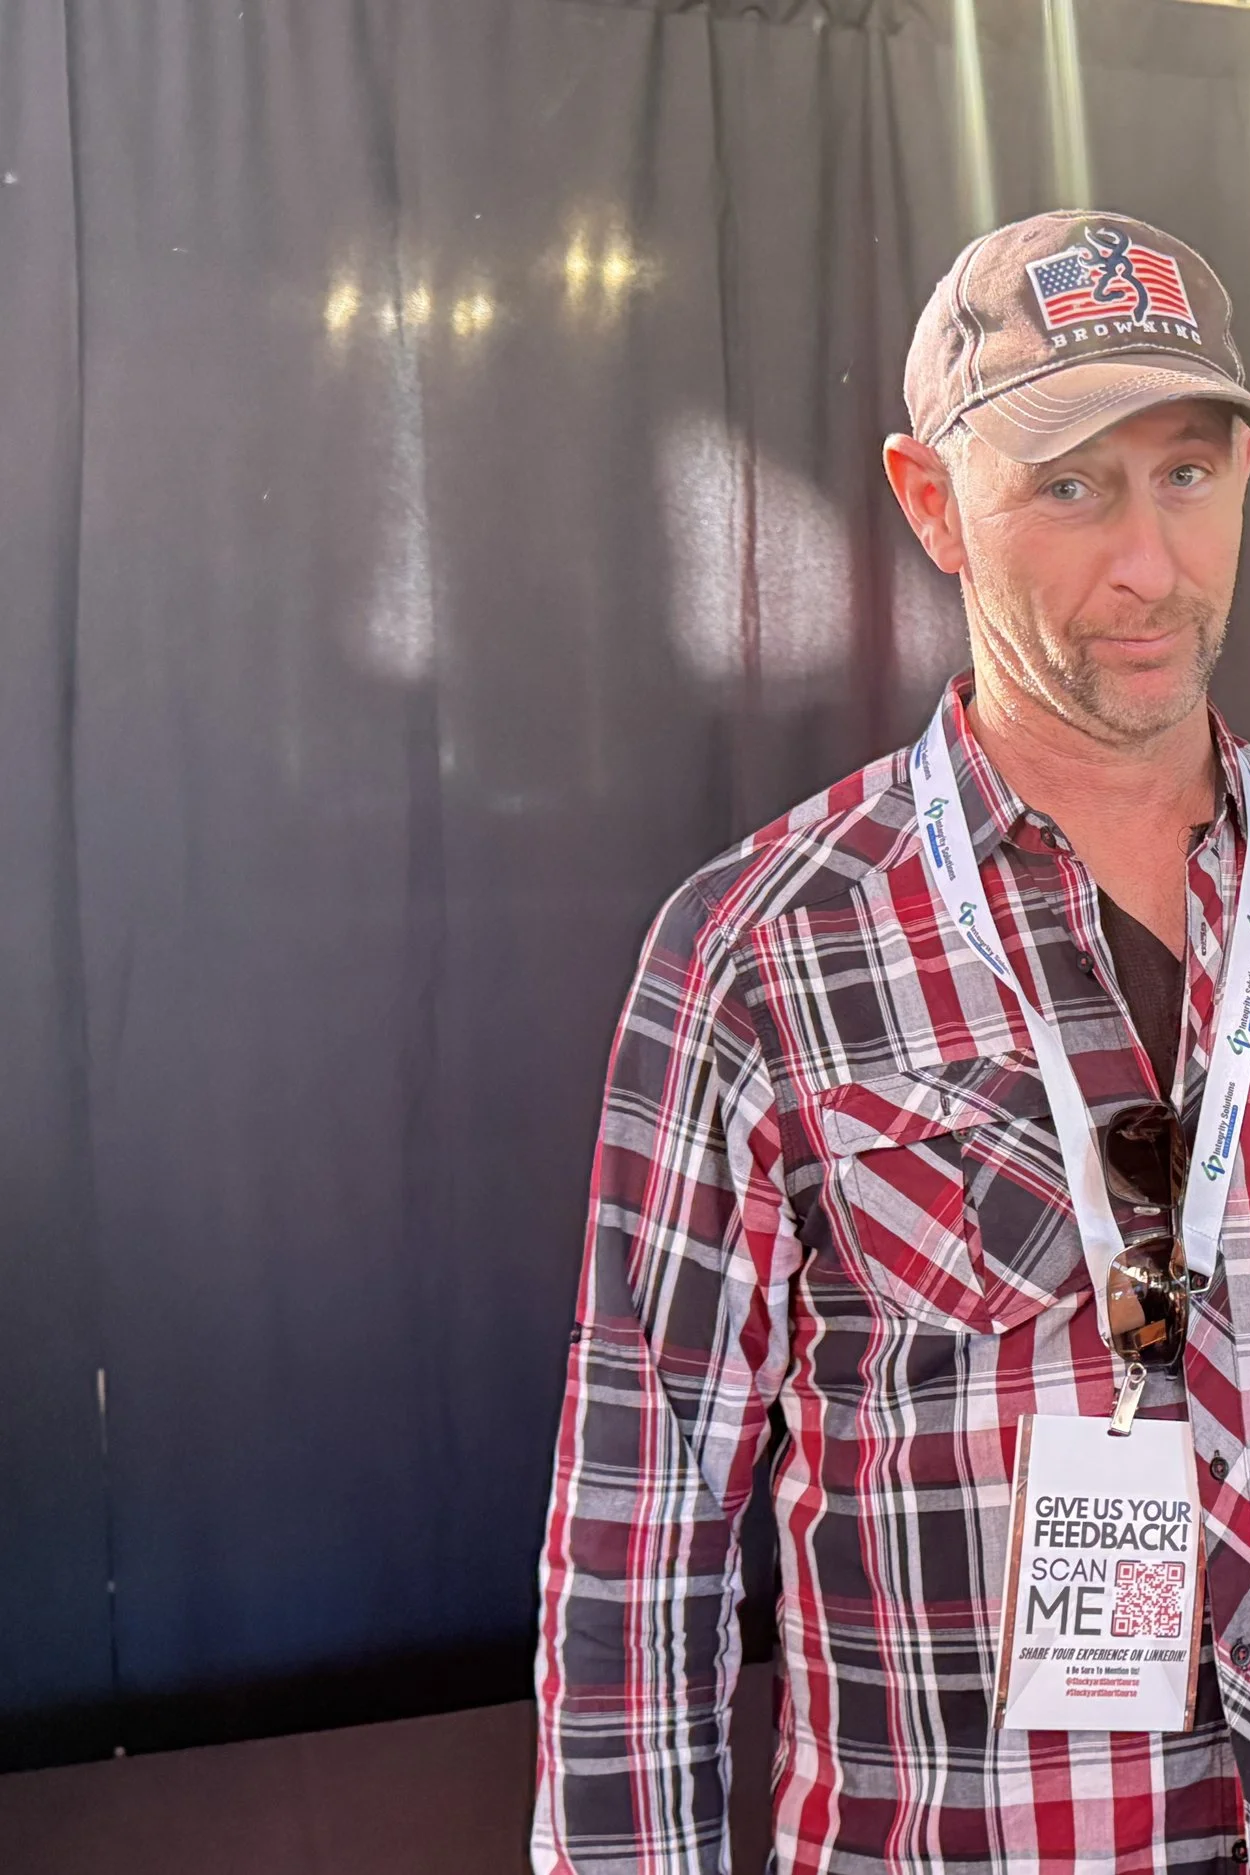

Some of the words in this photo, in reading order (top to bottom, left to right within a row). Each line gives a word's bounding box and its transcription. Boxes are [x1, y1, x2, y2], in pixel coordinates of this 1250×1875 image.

[1051, 320, 1202, 348] BROWNING
[934, 818, 947, 848] Integrity
[941, 845, 956, 881] Solutions
[970, 925, 994, 956] Integrity
[1220, 1081, 1236, 1120] Solutions
[1213, 1119, 1229, 1156] Integrity
[1035, 1496, 1089, 1519] GIVE
[1093, 1498, 1123, 1520] US
[1127, 1499, 1192, 1523] YOUR
[1034, 1520, 1188, 1552] FEEDBACK!
[1031, 1557, 1107, 1583] SCAN
[1025, 1585, 1105, 1636] ME
[1019, 1647, 1050, 1660] SHARE
[1051, 1647, 1074, 1660] YOUR
[1075, 1648, 1130, 1661] EXPERIENCE
[1129, 1649, 1143, 1661] ON
[1143, 1649, 1187, 1663] LINKEDIN!
[1071, 1666, 1079, 1674] Be
[1081, 1666, 1094, 1674] Sure
[1096, 1666, 1103, 1674] To
[1104, 1666, 1129, 1674] Mention
